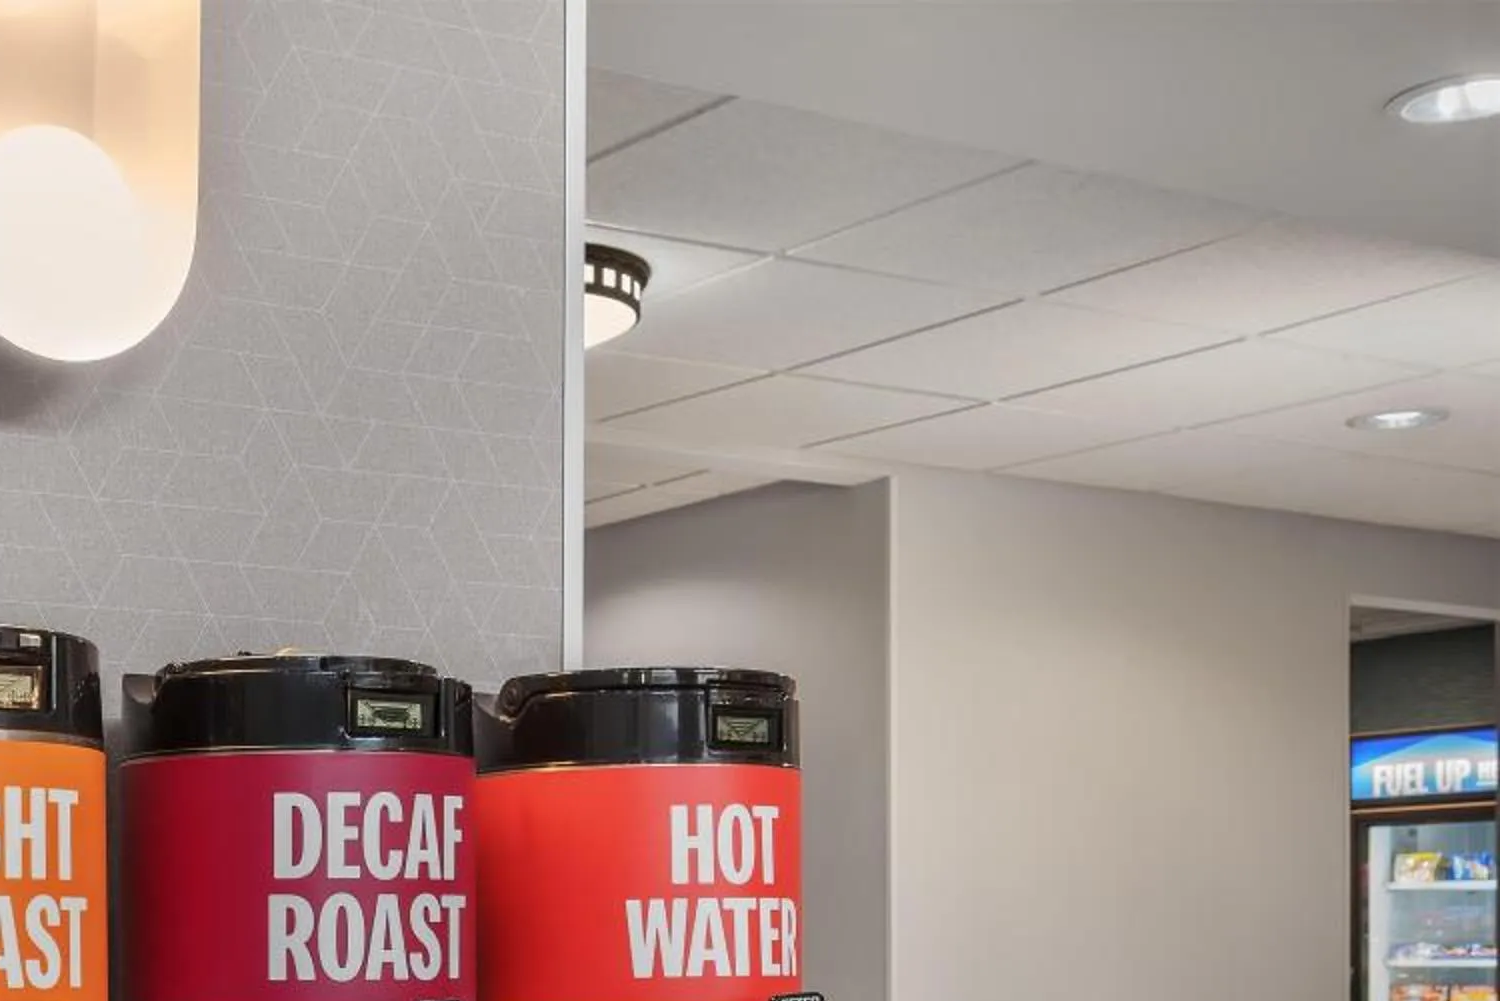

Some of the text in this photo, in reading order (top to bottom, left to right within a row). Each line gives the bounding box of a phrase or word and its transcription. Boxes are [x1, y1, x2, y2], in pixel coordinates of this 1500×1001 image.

[1373, 761, 1428, 798] FUEL
[1435, 758, 1471, 793] UP
[273, 791, 463, 881] DECAF
[670, 803, 779, 885] HOT
[267, 892, 466, 983] ROAST
[626, 897, 797, 979] WATER
